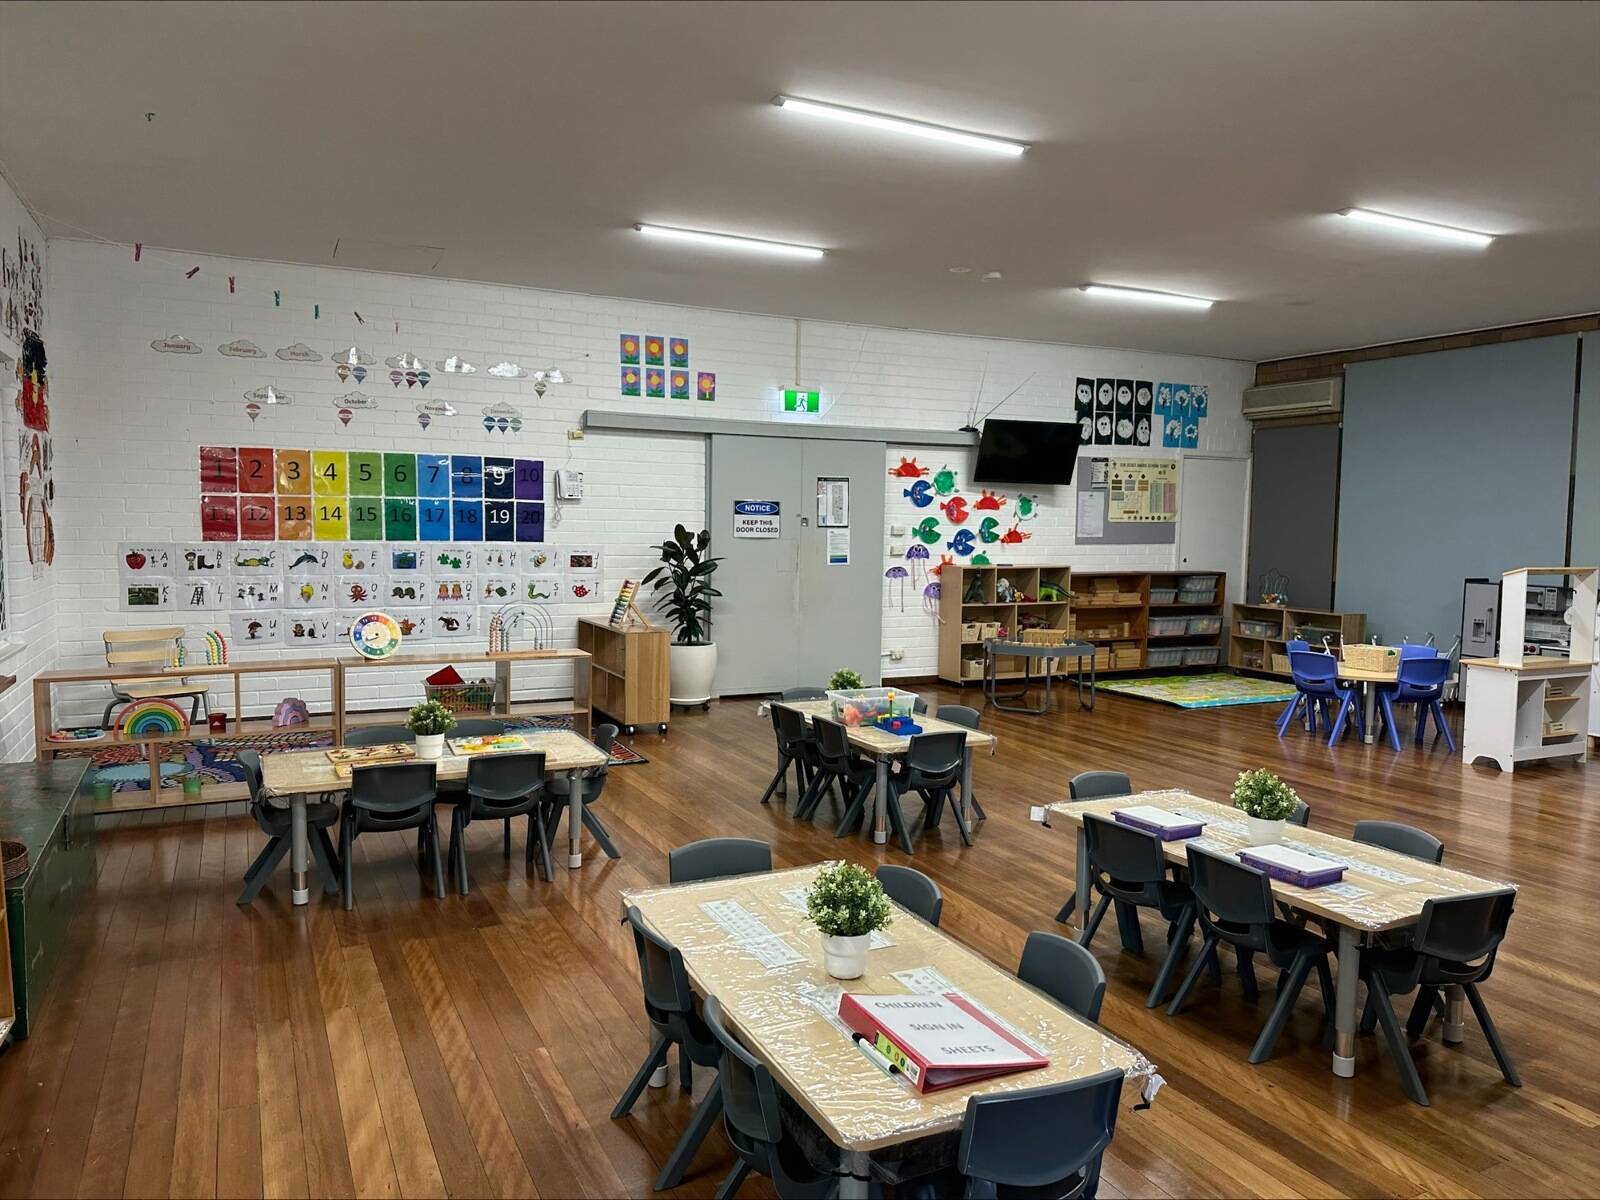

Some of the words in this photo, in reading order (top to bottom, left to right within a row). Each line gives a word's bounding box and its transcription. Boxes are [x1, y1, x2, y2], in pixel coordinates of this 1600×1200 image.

[164, 342, 190, 350] January
[216, 460, 222, 477] 1
[251, 460, 262, 478] 2
[288, 462, 300, 480] 3
[324, 463, 337, 481] 4
[360, 464, 371, 481] 5
[394, 465, 406, 482] 6
[428, 466, 440, 483] 7
[461, 466, 472, 484] 8
[493, 467, 506, 485] 9
[520, 468, 539, 482] 10
[208, 506, 231, 520] 11
[248, 506, 269, 521] 12
[285, 506, 306, 521] 13
[320, 506, 343, 521] 14
[356, 507, 376, 521] 15
[392, 508, 411, 522] 16
[425, 508, 444, 522] 17
[458, 509, 477, 523] 18
[490, 510, 510, 524] 19
[522, 510, 540, 524] 20
[163, 586, 168, 594] K
[218, 586, 224, 594] L
[595, 582, 599, 591] T
[270, 620, 276, 628] U
[941, 1045, 996, 1054] SHEETS
